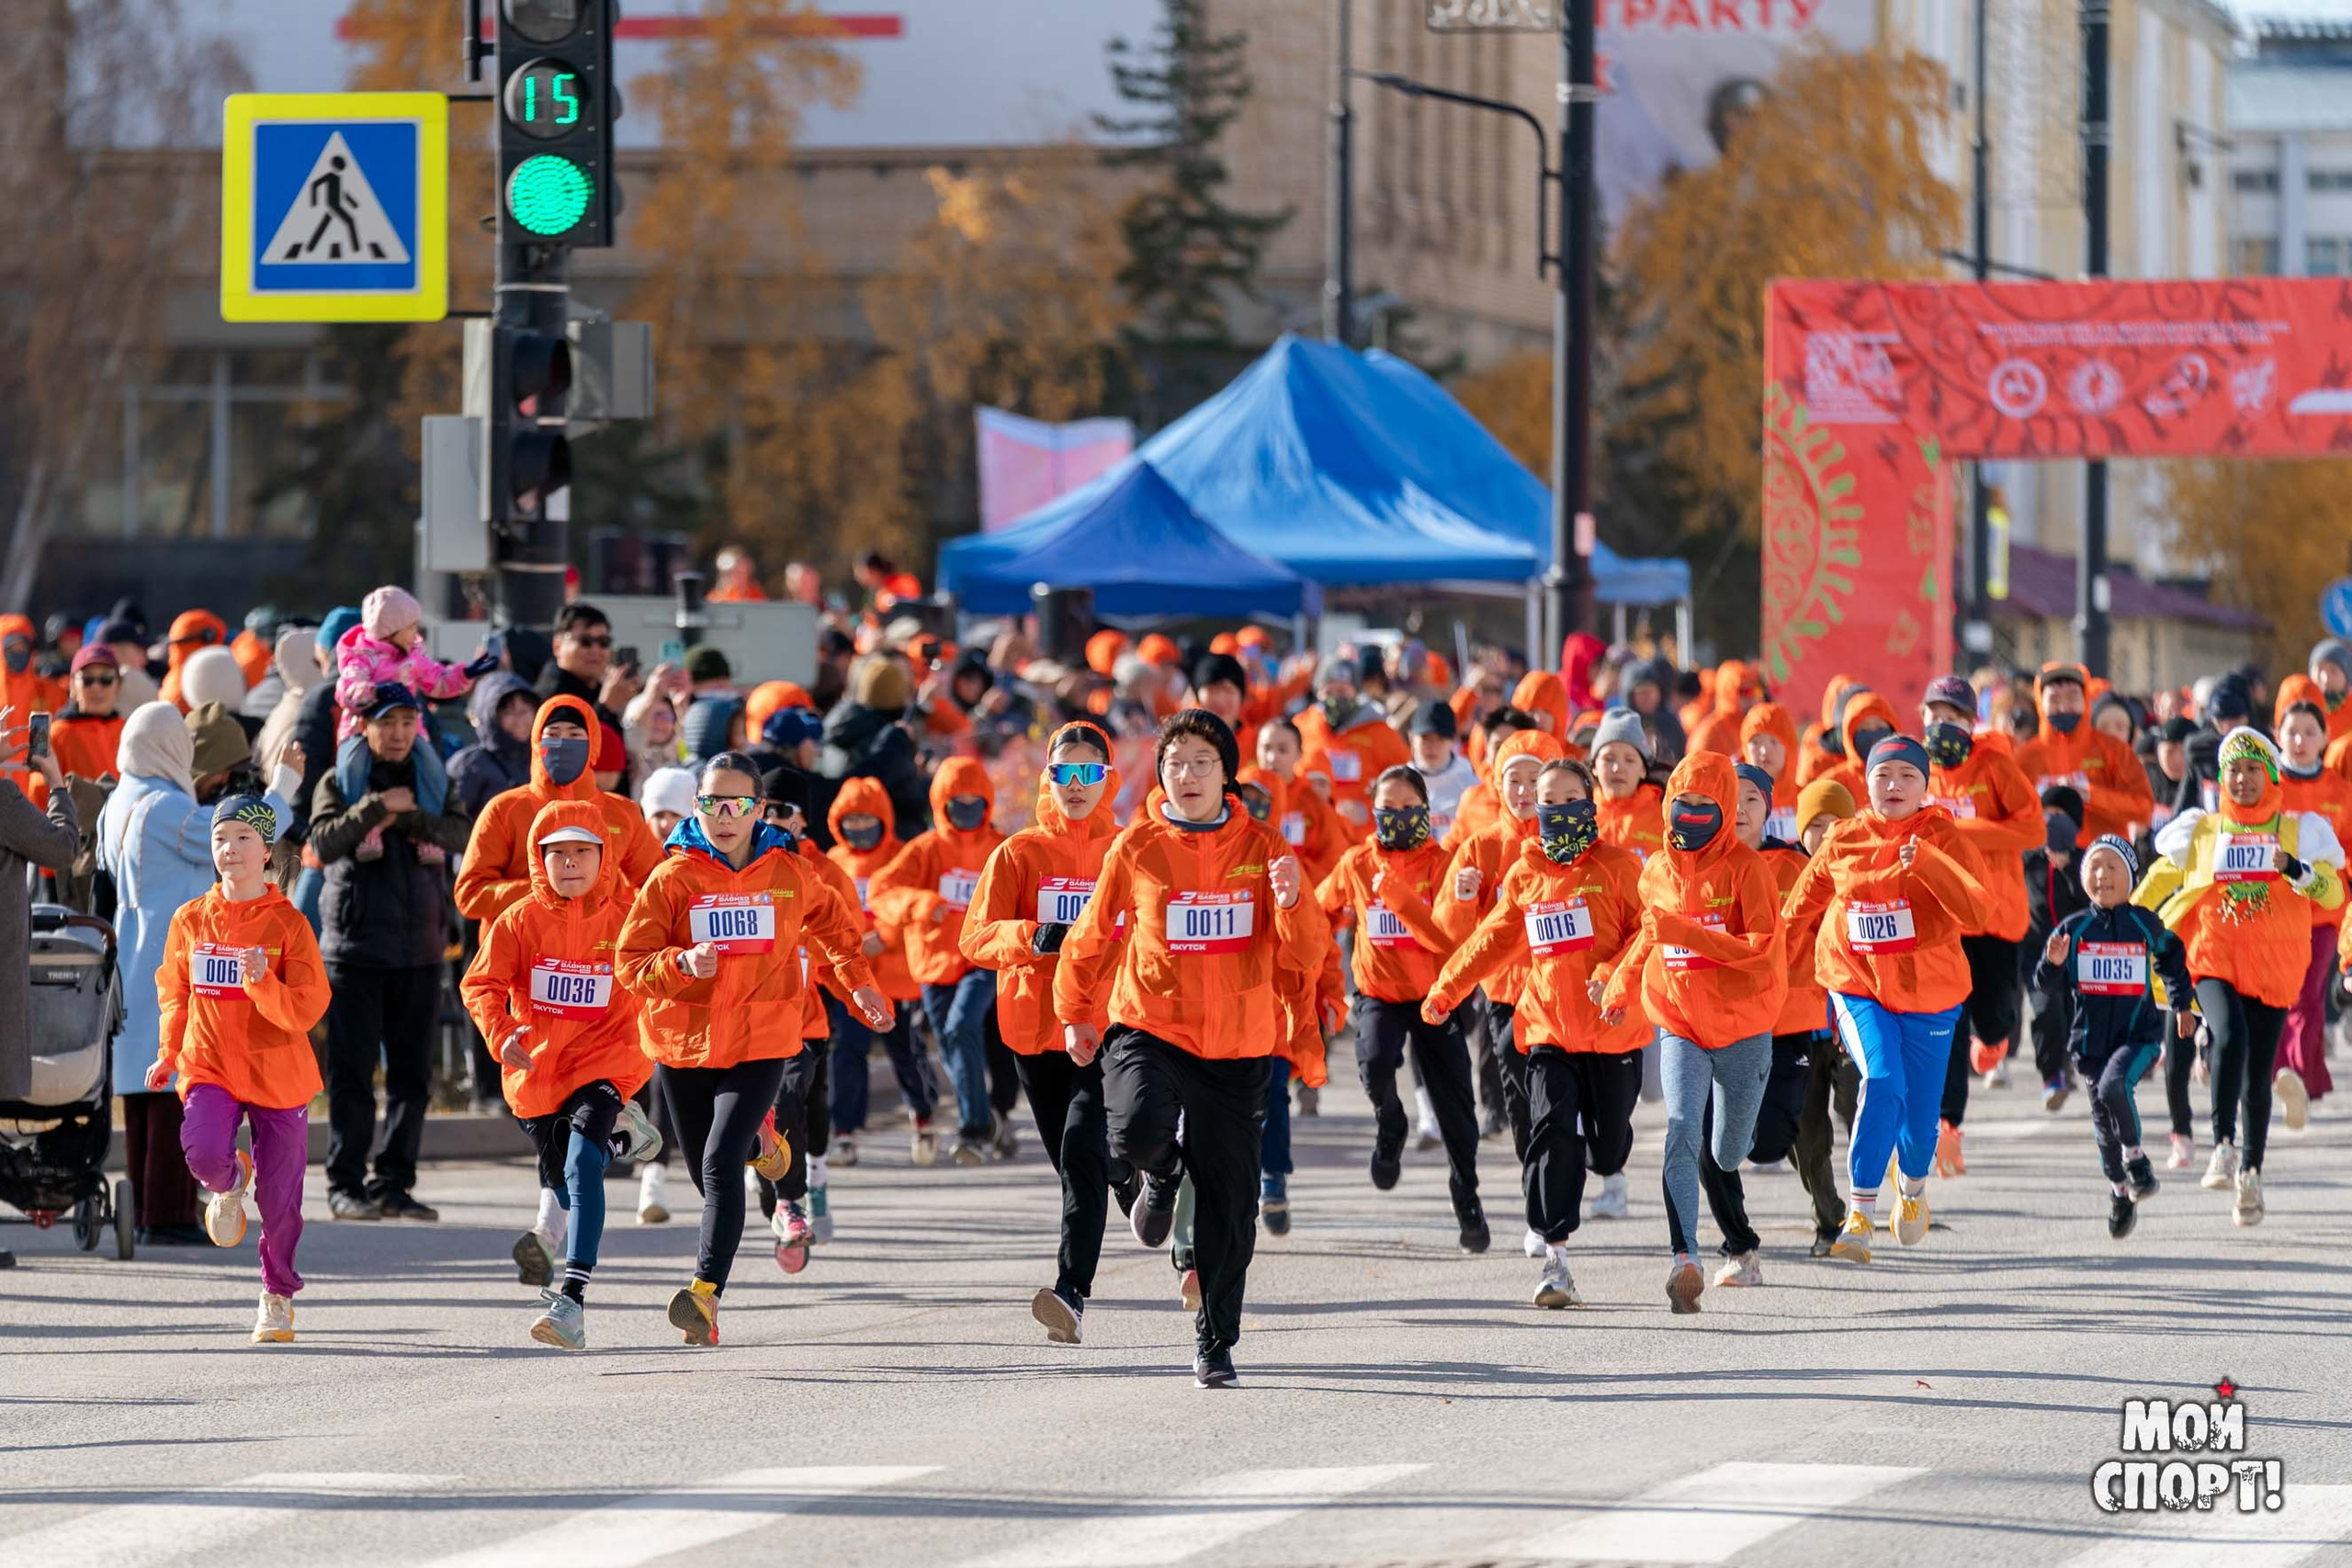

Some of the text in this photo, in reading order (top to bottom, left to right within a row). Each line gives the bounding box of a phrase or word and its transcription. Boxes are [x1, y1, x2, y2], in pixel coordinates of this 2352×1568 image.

[525, 73, 579, 123] 15
[2226, 846, 2266, 870] 0027
[708, 908, 758, 938] 0068
[1186, 908, 1234, 937] 0011
[1536, 913, 1577, 942] 0016
[1858, 915, 1898, 940] 0026
[1170, 943, 1207, 952] ЯКУТСК
[48, 972, 74, 980] TREND
[206, 958, 243, 986] 006
[2093, 958, 2133, 980] 0035
[548, 976, 596, 1004] 0036
[533, 1004, 564, 1015] ЯКУТСК
